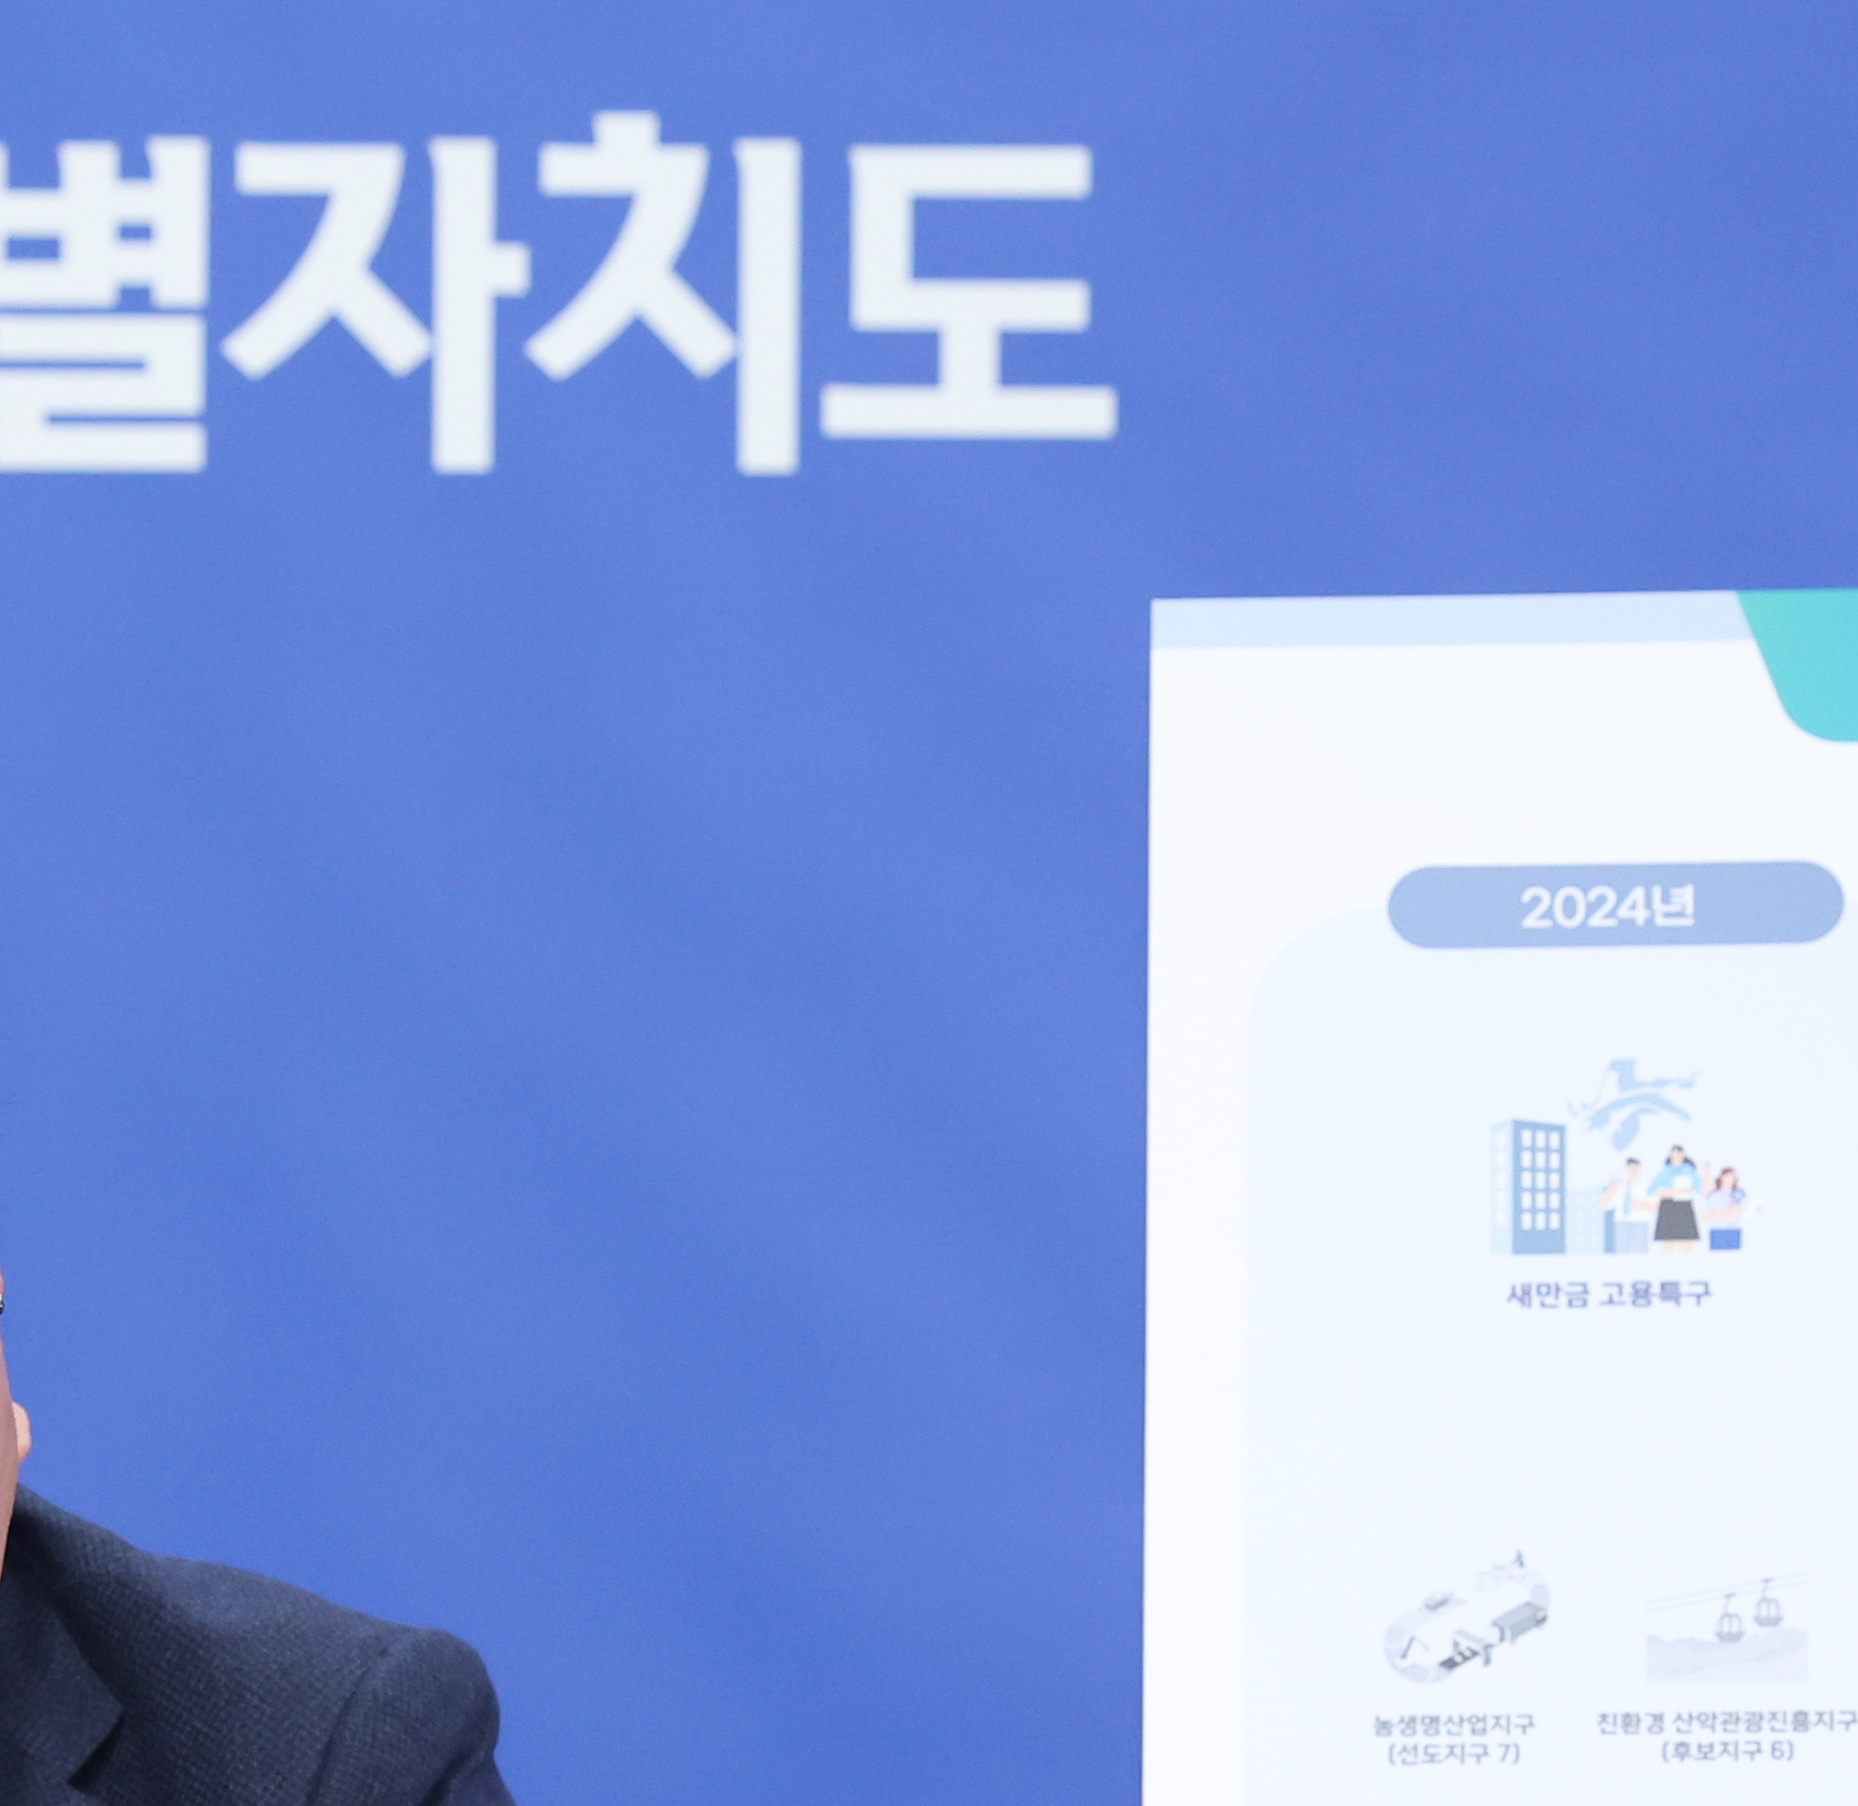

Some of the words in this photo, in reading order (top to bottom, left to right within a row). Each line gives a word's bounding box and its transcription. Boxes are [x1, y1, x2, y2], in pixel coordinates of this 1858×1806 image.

[1519, 883, 1696, 929] 2024년
[1506, 1281, 1591, 1309] 새만금
[1599, 1280, 1713, 1307] 고용특구
[1373, 1713, 1536, 1737] 농생명산업지구
[1596, 1711, 1665, 1735] 친환경
[1387, 1743, 1490, 1766] (선도지구
[1497, 1742, 1521, 1765] 7)
[1660, 1739, 1765, 1762] (후보지구
[1770, 1738, 1795, 1762] 6)
